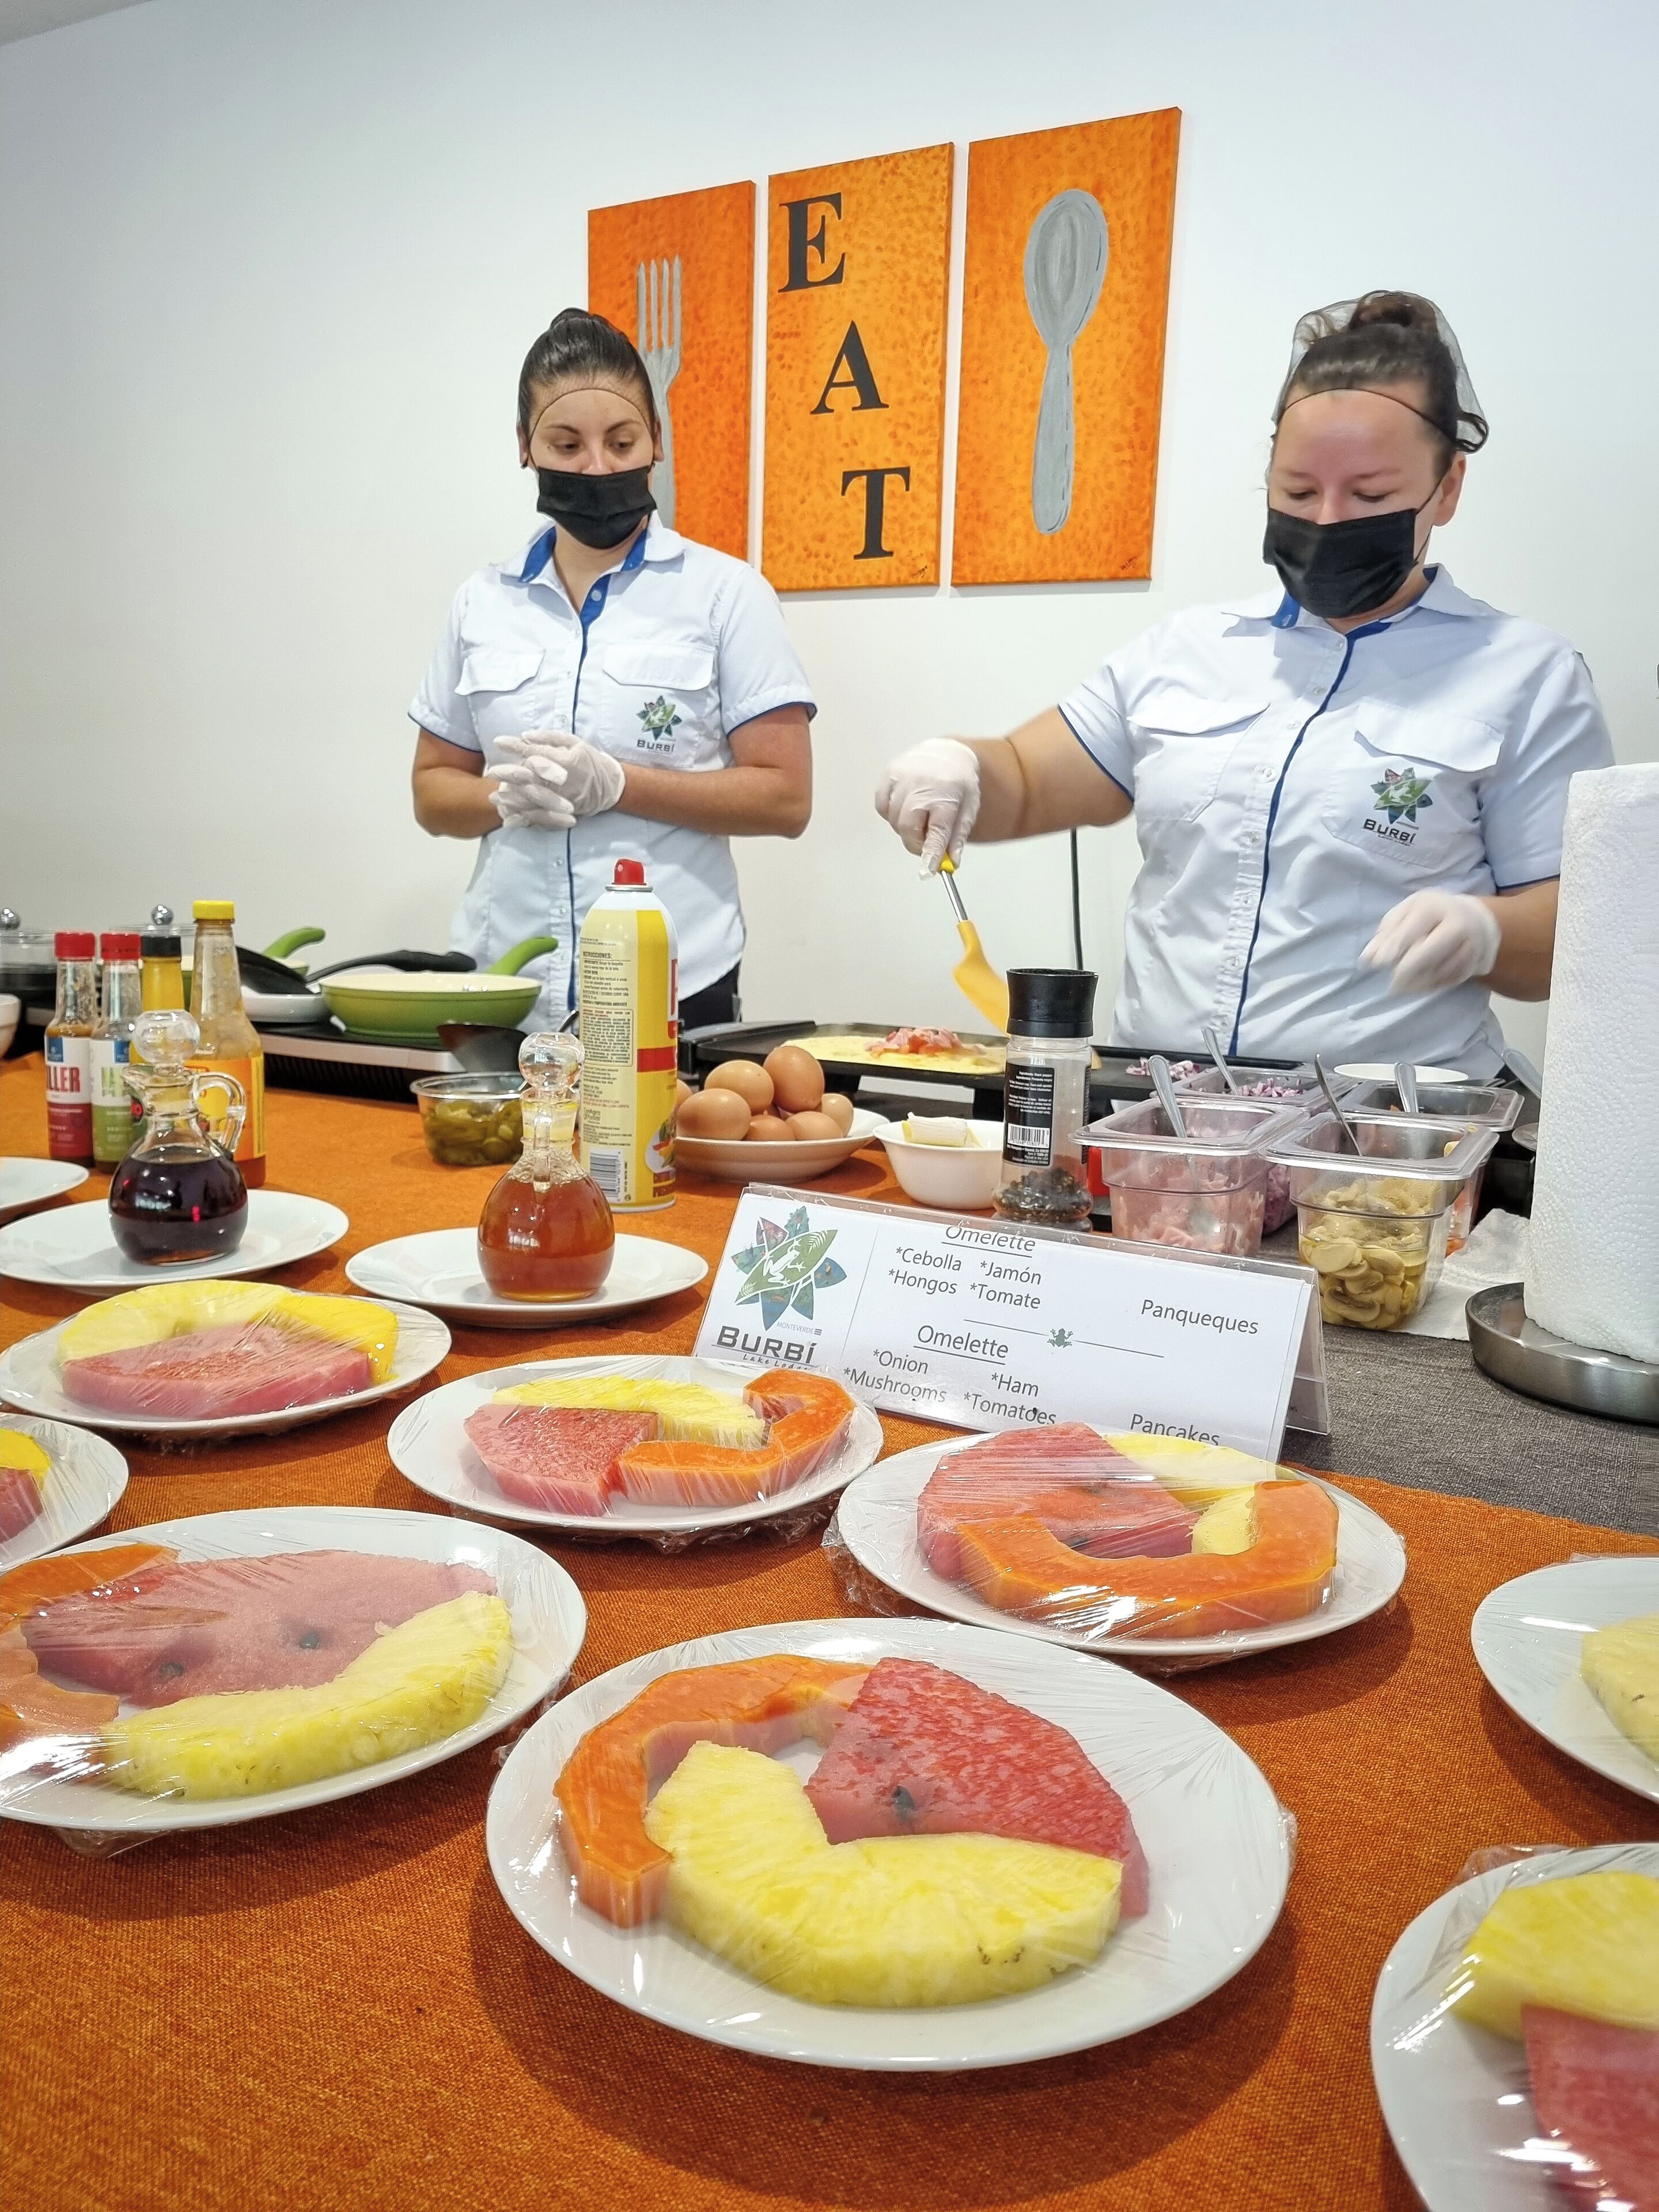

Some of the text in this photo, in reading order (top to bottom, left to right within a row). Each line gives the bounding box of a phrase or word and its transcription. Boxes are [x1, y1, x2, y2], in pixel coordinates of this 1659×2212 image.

[945, 1225, 1036, 1252] Omelette
[776, 1321, 815, 1335] MONTEVERDE
[1141, 1299, 1259, 1335] Panqueques
[917, 1324, 1009, 1358] Omelette
[743, 1354, 770, 1365] Lake
[1130, 1413, 1220, 1446] Pancakes
